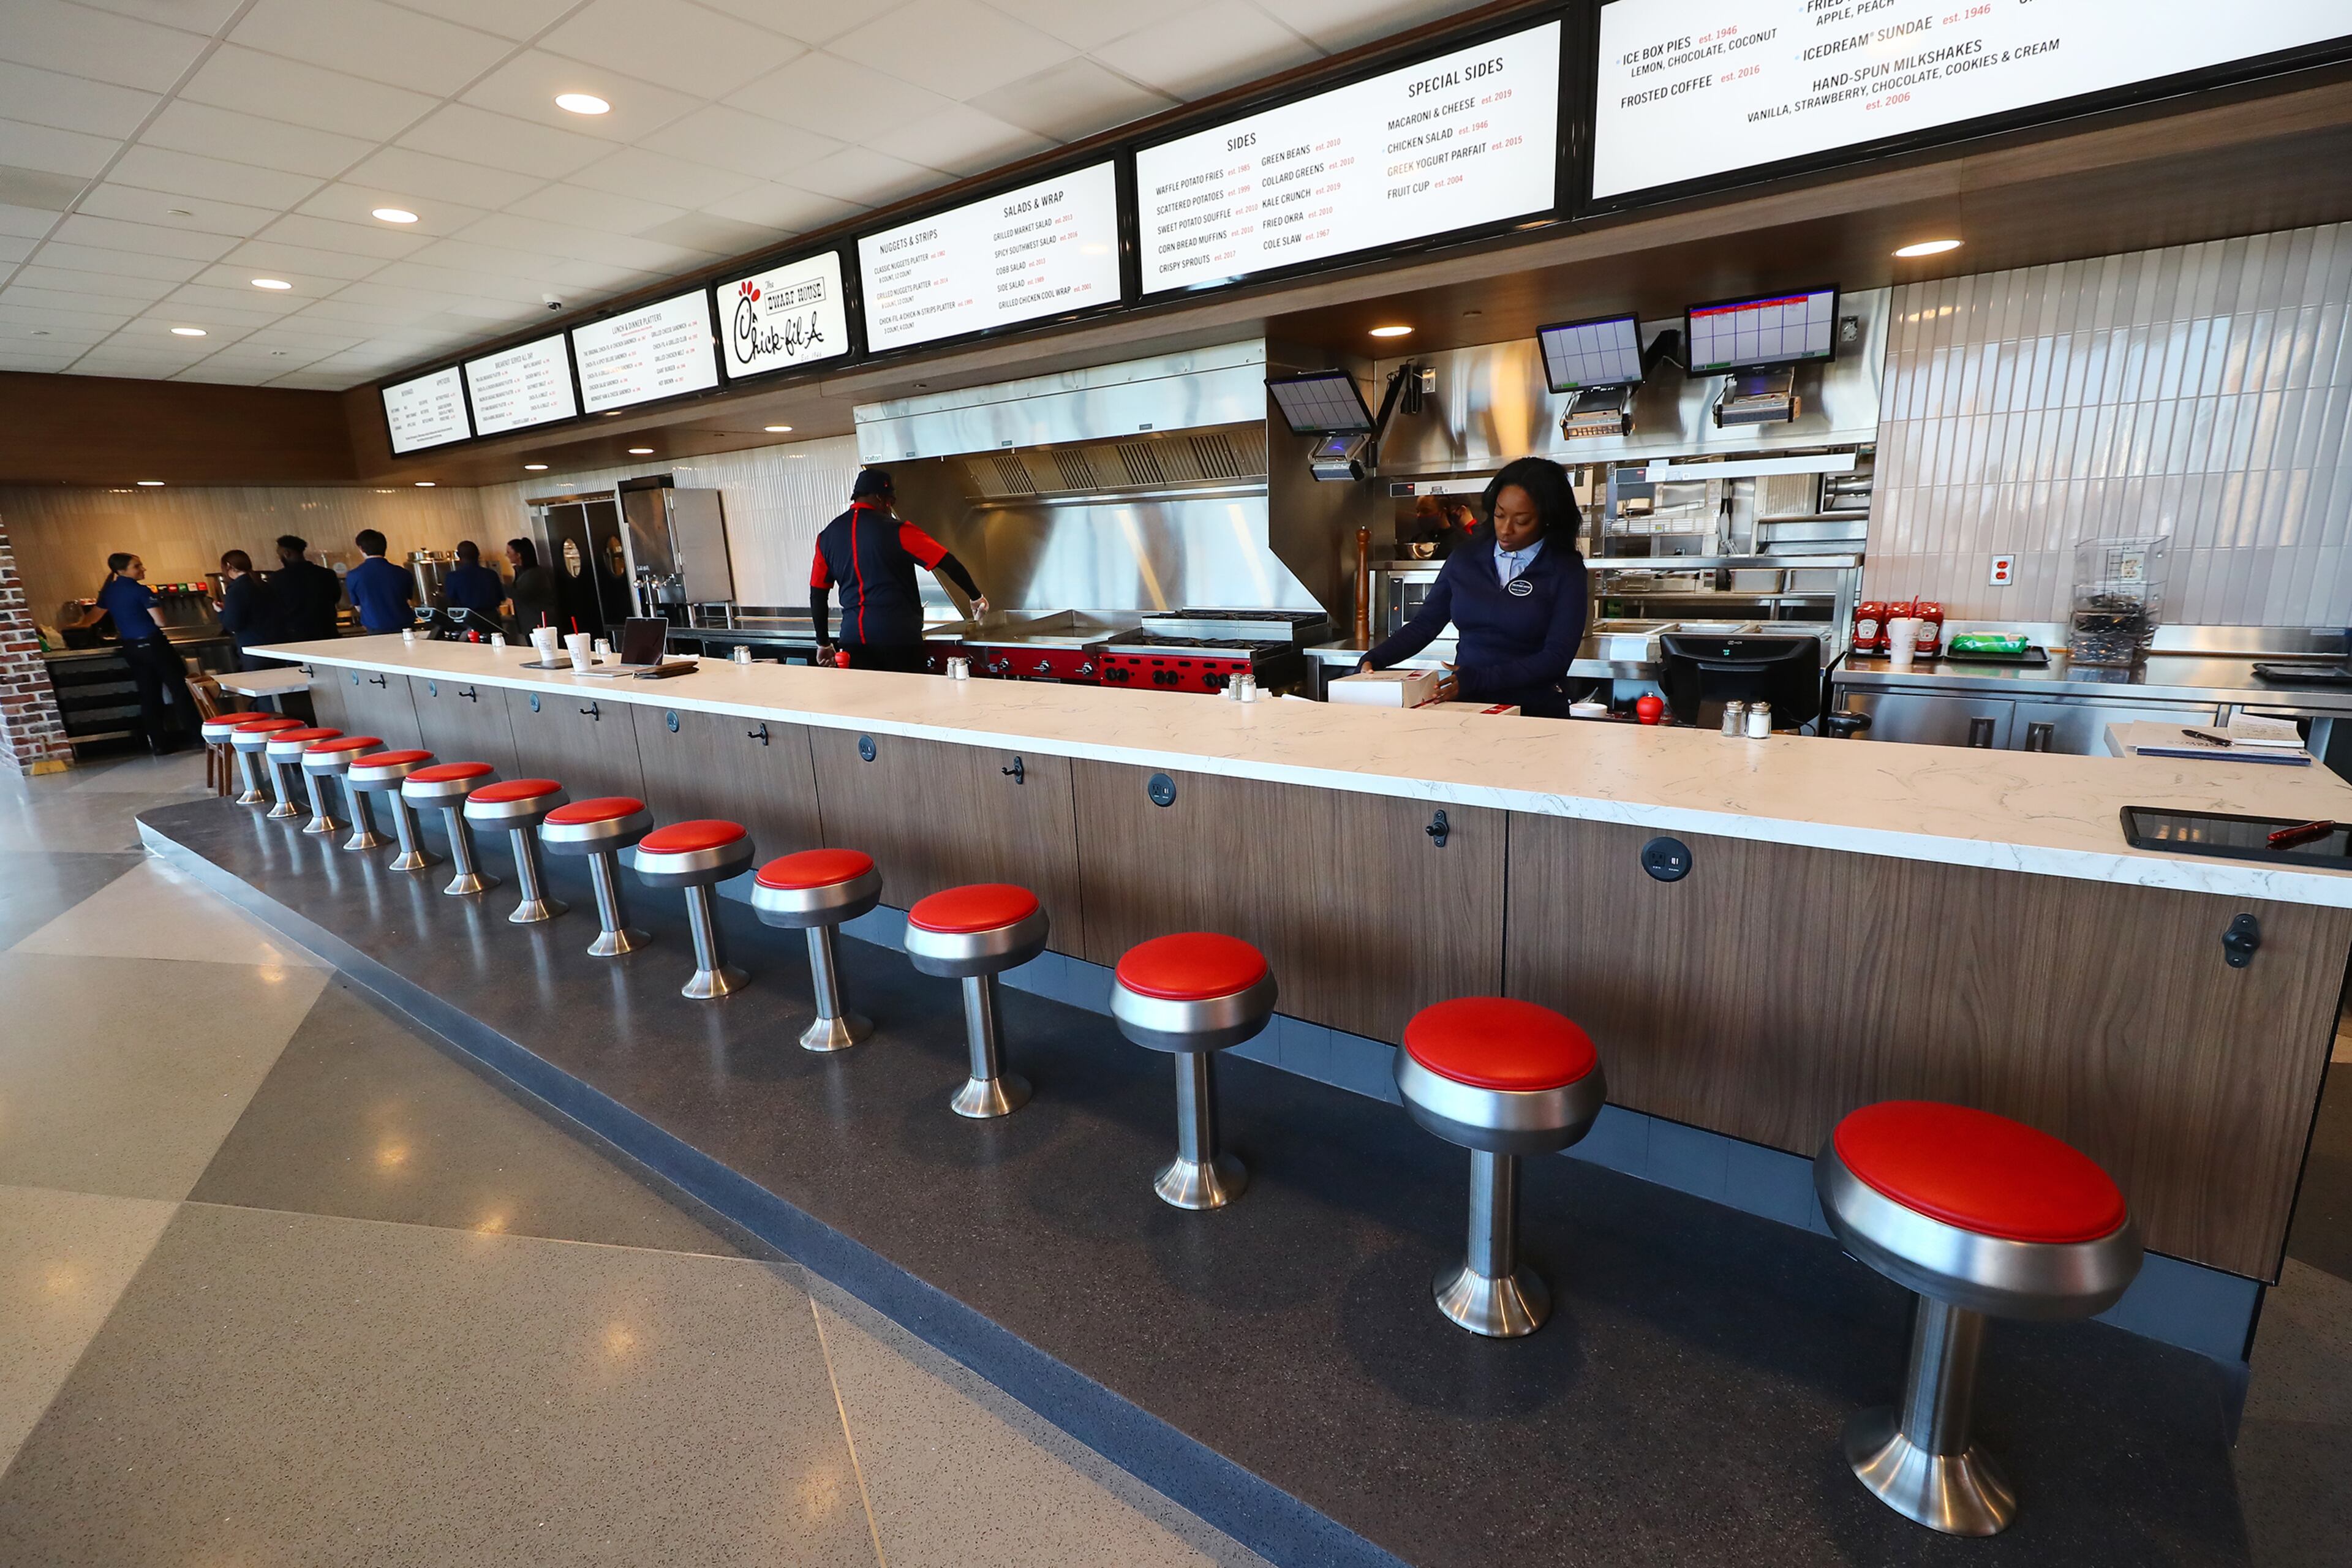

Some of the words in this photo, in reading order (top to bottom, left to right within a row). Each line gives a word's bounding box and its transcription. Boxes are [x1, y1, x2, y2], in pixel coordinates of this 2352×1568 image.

[1816, 7, 1854, 26] APPLE,
[1856, 0, 1894, 15] PEACH
[1877, 15, 1933, 42] SUNDAE
[1942, 12, 1961, 25] est.
[1964, 3, 1991, 20] 1946
[1623, 50, 1640, 66] ICE
[1642, 43, 1664, 60] BOX
[1667, 36, 1691, 53] PIES
[1698, 32, 1714, 45] est.
[1716, 24, 1738, 40] 1946
[1631, 60, 1665, 78] LEMON,
[1667, 43, 1726, 67] CHOCOLATE,
[1728, 28, 1777, 51] COCONUT
[1408, 70, 1461, 98] SPECIAL
[1465, 57, 1503, 81] SIDES
[1747, 104, 1792, 123] VANILLA,
[1795, 85, 1869, 112] STRAWBERRY,
[1872, 69, 1942, 94] CHOCOLATE,
[1945, 54, 1997, 76] COOKIES
[2002, 51, 2010, 62] &
[2015, 38, 2060, 59] CREAM
[1812, 62, 1890, 92] HAND-SPUN
[1894, 39, 1982, 72] MILKSHAKES
[1621, 86, 1668, 109] FROSTED
[1670, 74, 1713, 96] COFFEE
[1721, 72, 1736, 83] est.
[1738, 64, 1760, 79] 2016
[1866, 99, 1883, 111] est.
[1885, 91, 1911, 107] 2006
[1388, 110, 1431, 131] MACARONI
[1433, 107, 1439, 118] &
[1442, 97, 1476, 116] CHEESE
[1481, 95, 1493, 105] est.
[1494, 88, 1512, 102] 2019
[1227, 132, 1256, 152] SIDES
[1261, 151, 1285, 167] GREEN
[1286, 144, 1311, 160] BEANS
[1315, 143, 1326, 152] est.
[1326, 137, 1341, 149] 2010
[1387, 135, 1423, 154] CHICKEN
[1425, 127, 1453, 144] SALAD
[1458, 126, 1471, 137] est.
[1472, 119, 1488, 132] 1946
[1262, 171, 1294, 188] COLLARD
[1295, 162, 1324, 179] GREENS
[1328, 161, 1339, 170] est.
[1340, 156, 1355, 167] 2010
[1387, 161, 1414, 177] GREEK
[1415, 151, 1449, 169] YOGURT
[1451, 142, 1487, 161] PARFAIT
[1491, 141, 1504, 151] est.
[1505, 135, 1523, 148] 2015
[1155, 181, 1180, 196] WAFFLE
[1180, 174, 1204, 189] POTATO
[1205, 168, 1224, 182] FRIES
[1227, 168, 1237, 176] est.
[1238, 163, 1251, 173] 1985
[1262, 195, 1280, 209] KALE
[1281, 188, 1311, 204] CRUNCH
[1316, 187, 1326, 195] est.
[1326, 182, 1341, 193] 2019
[1387, 184, 1411, 200] FRUIT
[1412, 180, 1430, 194] CUP
[1434, 179, 1446, 189] est.
[1447, 174, 1463, 186] 2004
[1004, 201, 1031, 217] SALADS
[1034, 198, 1039, 209] &
[1041, 191, 1063, 206] WRAP
[1156, 198, 1192, 216] SCATTERED
[1192, 189, 1224, 206] POTATOES
[1227, 189, 1237, 197] est.
[1238, 184, 1251, 195] 1999
[1157, 222, 1177, 235] SWEET
[1178, 216, 1202, 230] POTATO
[1202, 208, 1231, 224] SOUFFLE
[1245, 203, 1259, 213] 2010
[1262, 216, 1283, 230] FRIED
[1284, 211, 1304, 224] OKRA
[1308, 210, 1318, 219] est.
[1318, 206, 1333, 216] 2010
[880, 238, 907, 254] NUGGETS
[915, 229, 938, 244] STRIPS
[1158, 243, 1175, 255] CORN
[1176, 237, 1197, 251] BREAD
[1198, 230, 1227, 244] MUFFINS
[1240, 225, 1254, 235] 2010
[1263, 238, 1281, 251] COLE
[1282, 233, 1302, 246] SLAW
[1305, 233, 1316, 241] est.
[1316, 228, 1330, 239] 1967
[1159, 261, 1181, 274] CRISPY
[1182, 254, 1210, 269] SPROUTS
[1223, 250, 1237, 260] 2017
[767, 290, 794, 310] DWARF
[797, 282, 822, 303] HOUSE
[734, 296, 824, 364] Chick-fil-A
